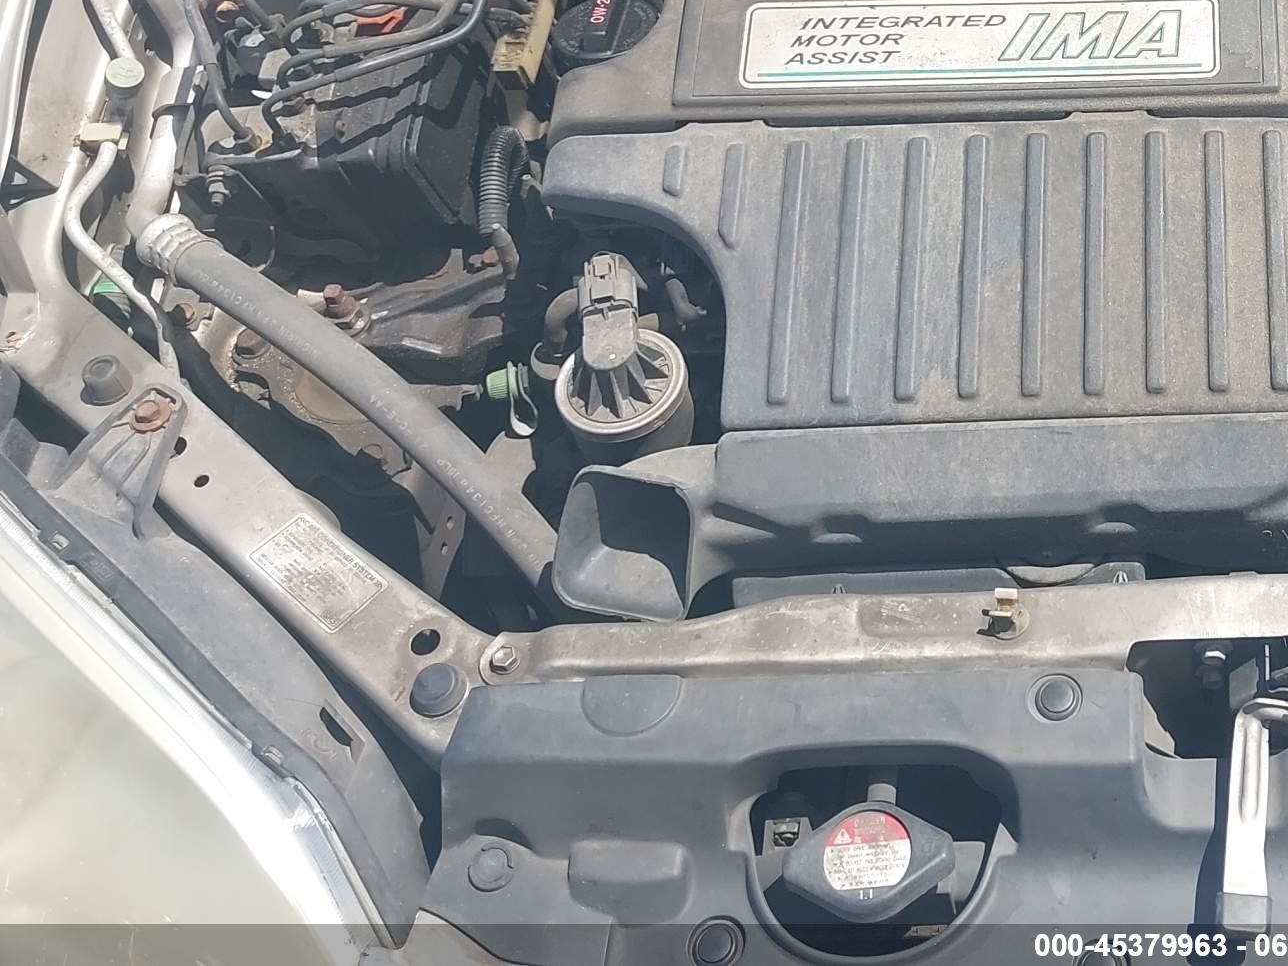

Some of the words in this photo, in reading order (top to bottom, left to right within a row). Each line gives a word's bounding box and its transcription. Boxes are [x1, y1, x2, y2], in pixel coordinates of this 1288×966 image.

[801, 14, 1007, 30] INTEGRATED
[790, 33, 905, 48] MOTOR
[998, 10, 1182, 61] IMA
[784, 50, 902, 66] ASSIST
[351, 560, 375, 583] SYSTEM
